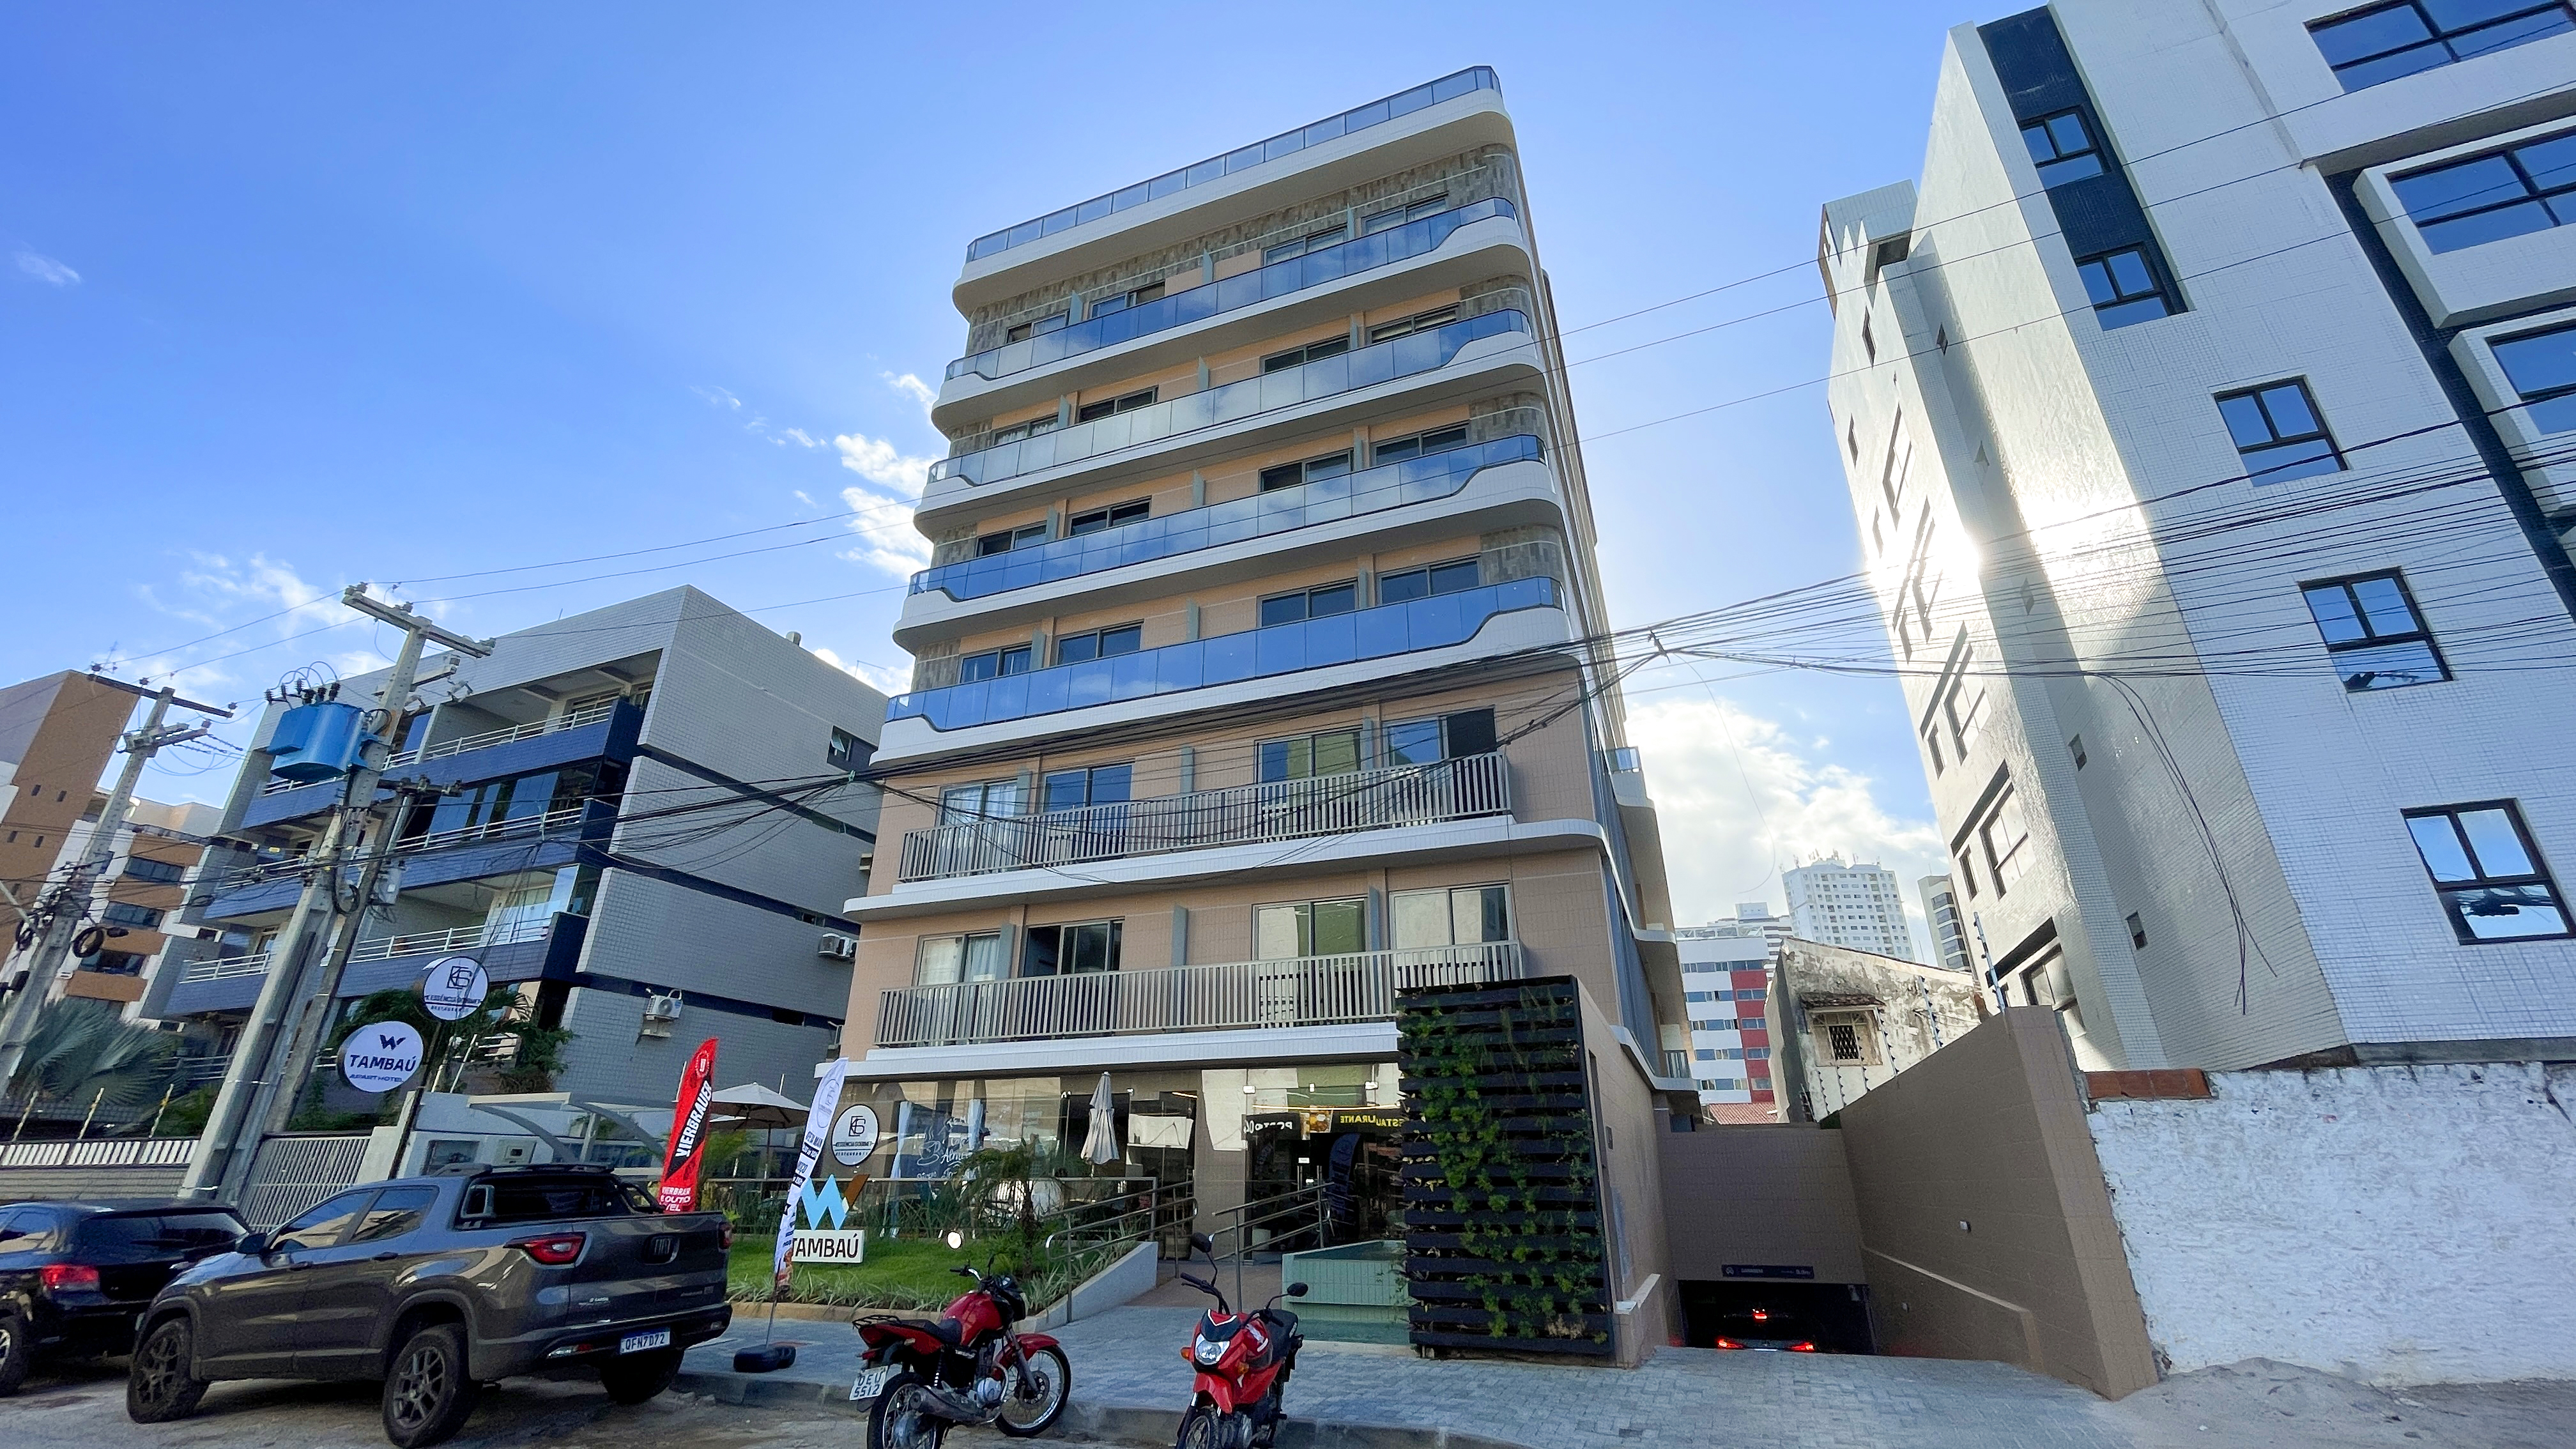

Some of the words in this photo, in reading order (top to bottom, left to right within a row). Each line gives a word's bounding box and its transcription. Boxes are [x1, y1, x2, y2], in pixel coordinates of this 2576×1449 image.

[350, 1054, 416, 1072] TAMBAÚ
[675, 1080, 712, 1157] VIERBRAUER
[792, 1233, 859, 1258] TAMBAÚ
